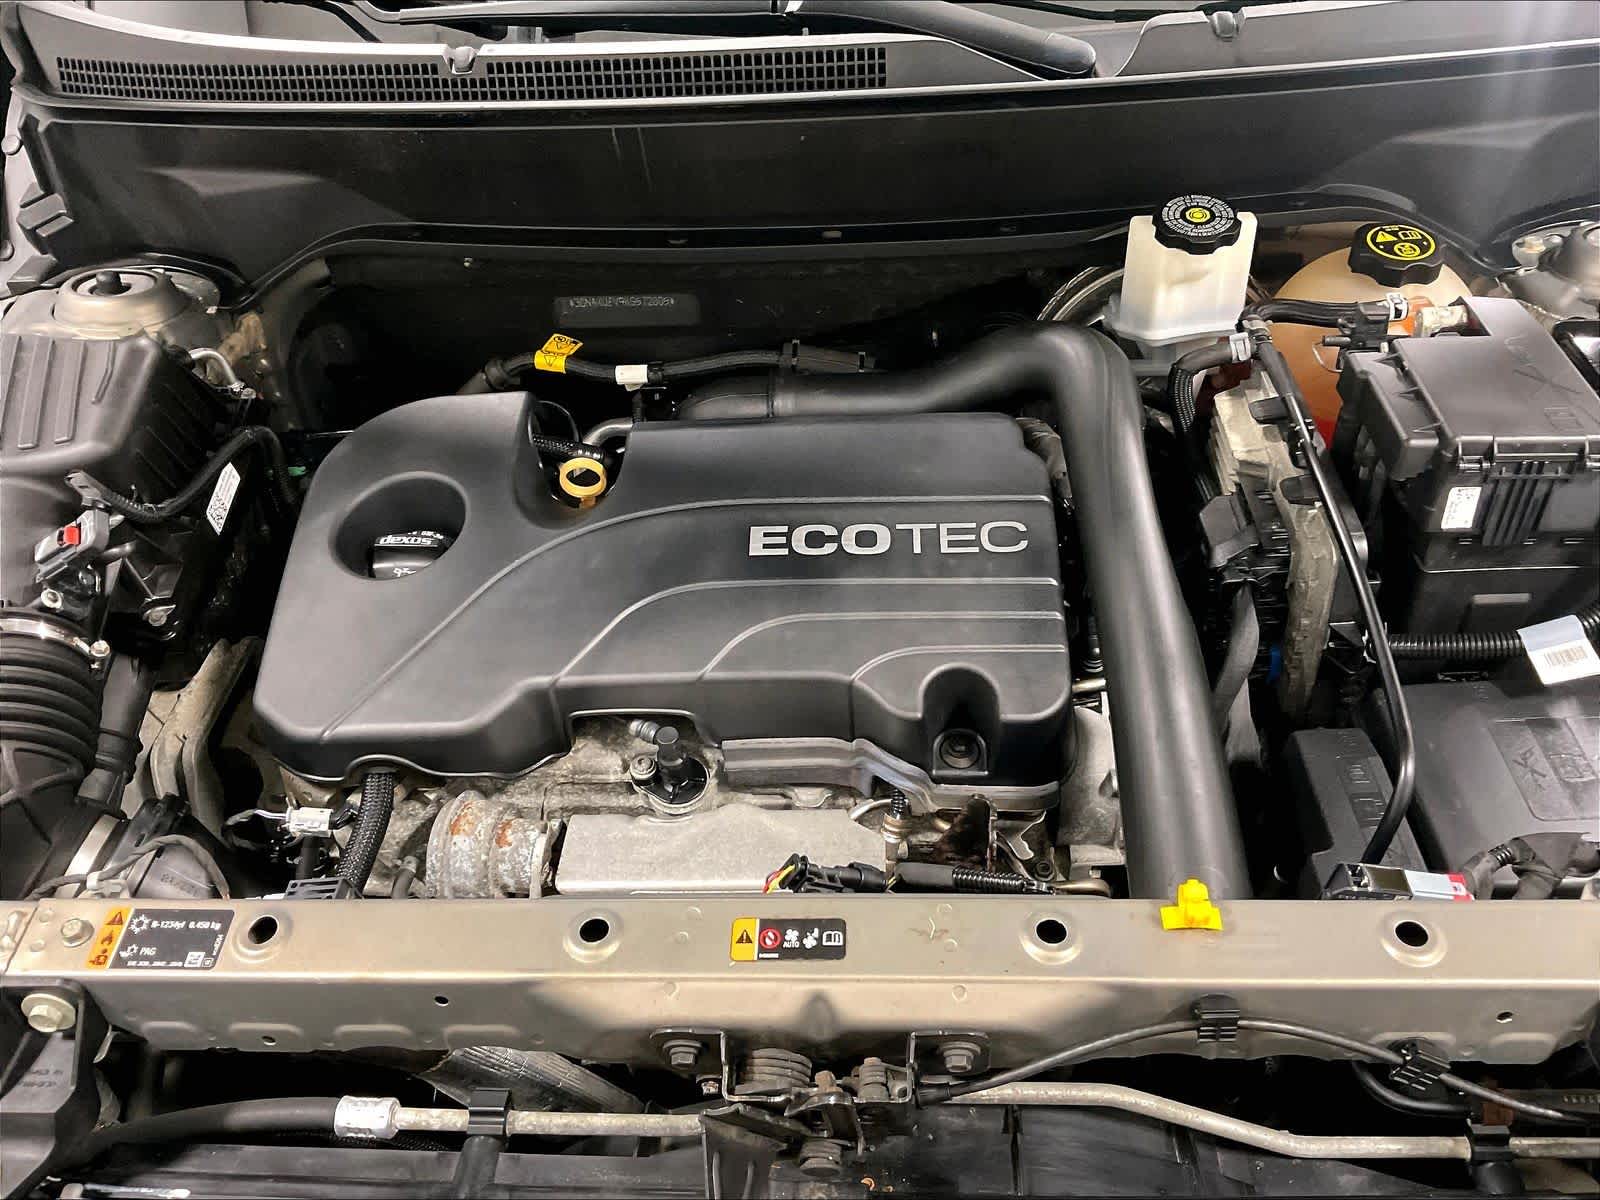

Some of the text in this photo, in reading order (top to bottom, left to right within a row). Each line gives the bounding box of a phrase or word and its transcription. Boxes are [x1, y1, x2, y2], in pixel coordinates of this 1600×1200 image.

[379, 534, 434, 545] dexos
[748, 520, 1028, 556] ECOTEC
[782, 940, 800, 949] AUTO
[139, 946, 156, 956] PAG
